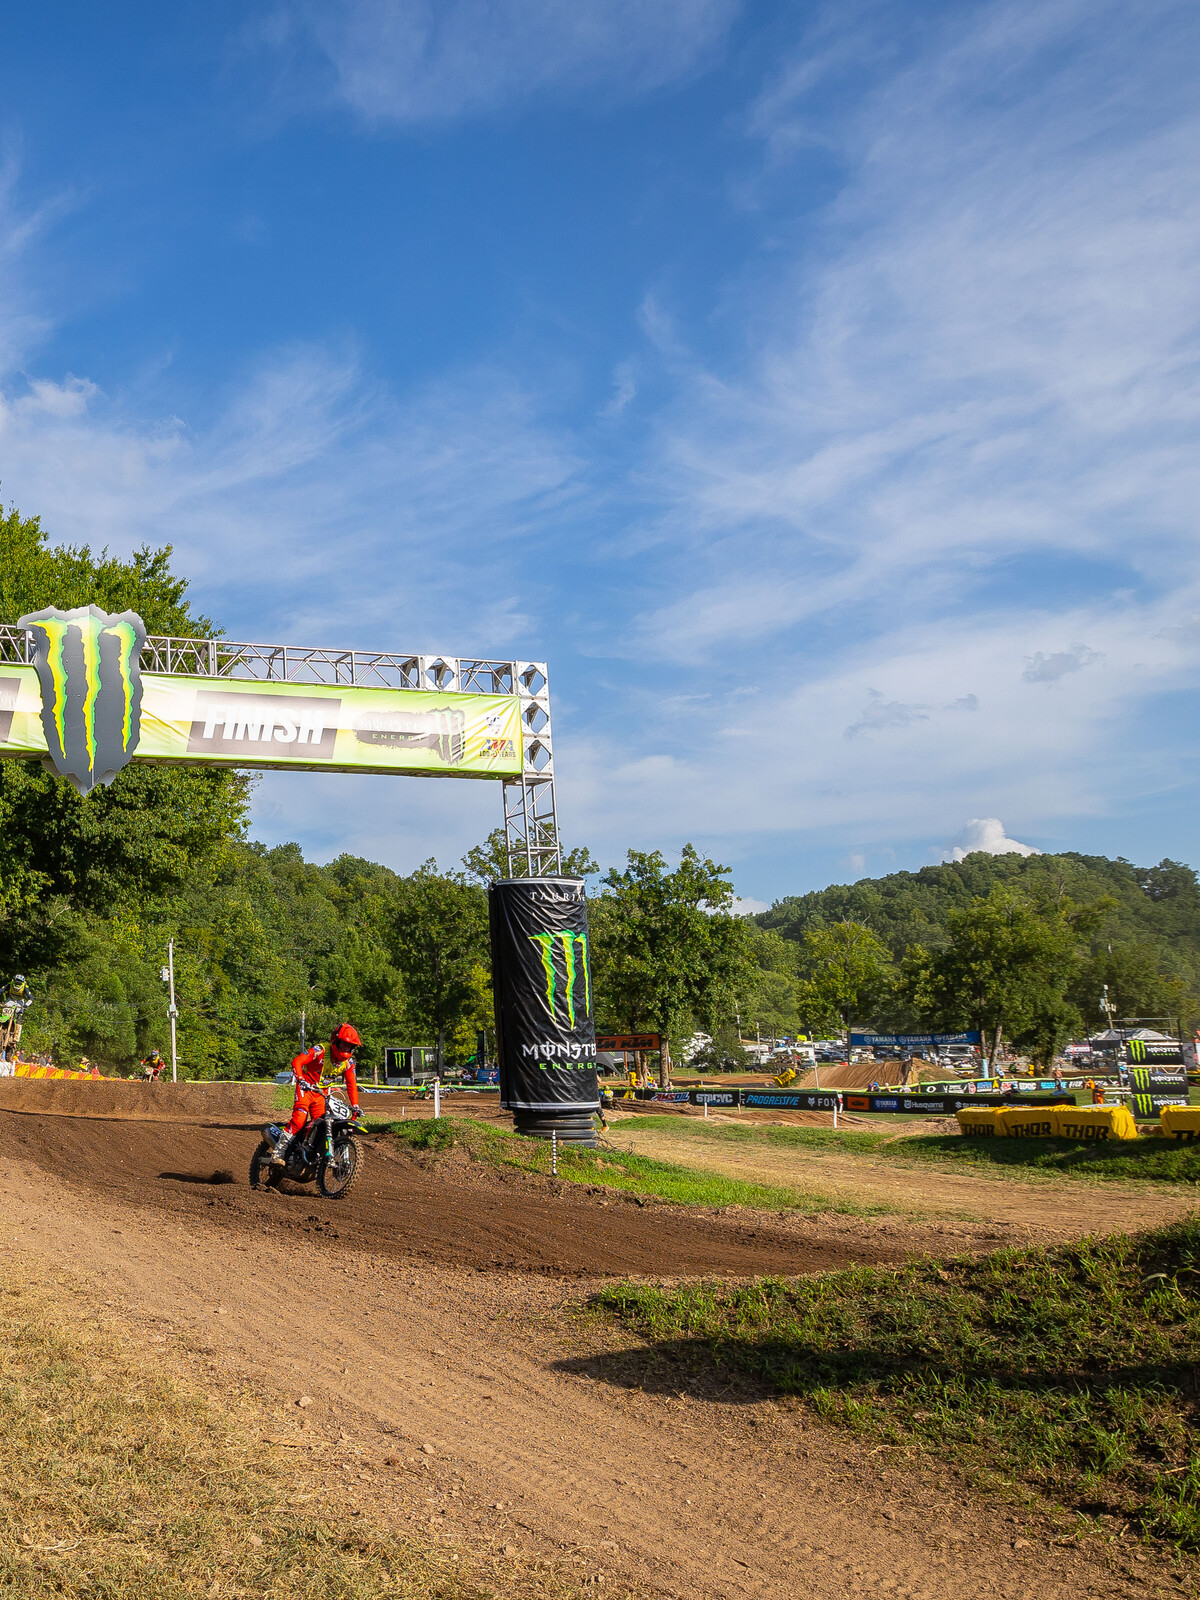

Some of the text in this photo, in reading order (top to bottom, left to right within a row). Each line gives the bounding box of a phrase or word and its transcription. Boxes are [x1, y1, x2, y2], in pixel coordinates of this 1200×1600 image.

[202, 703, 327, 745] FINISH
[596, 1037, 617, 1049] TM
[745, 1094, 800, 1106] PROGRESSIVE
[817, 1097, 837, 1107] FOX
[1062, 1123, 1110, 1140] THOR
